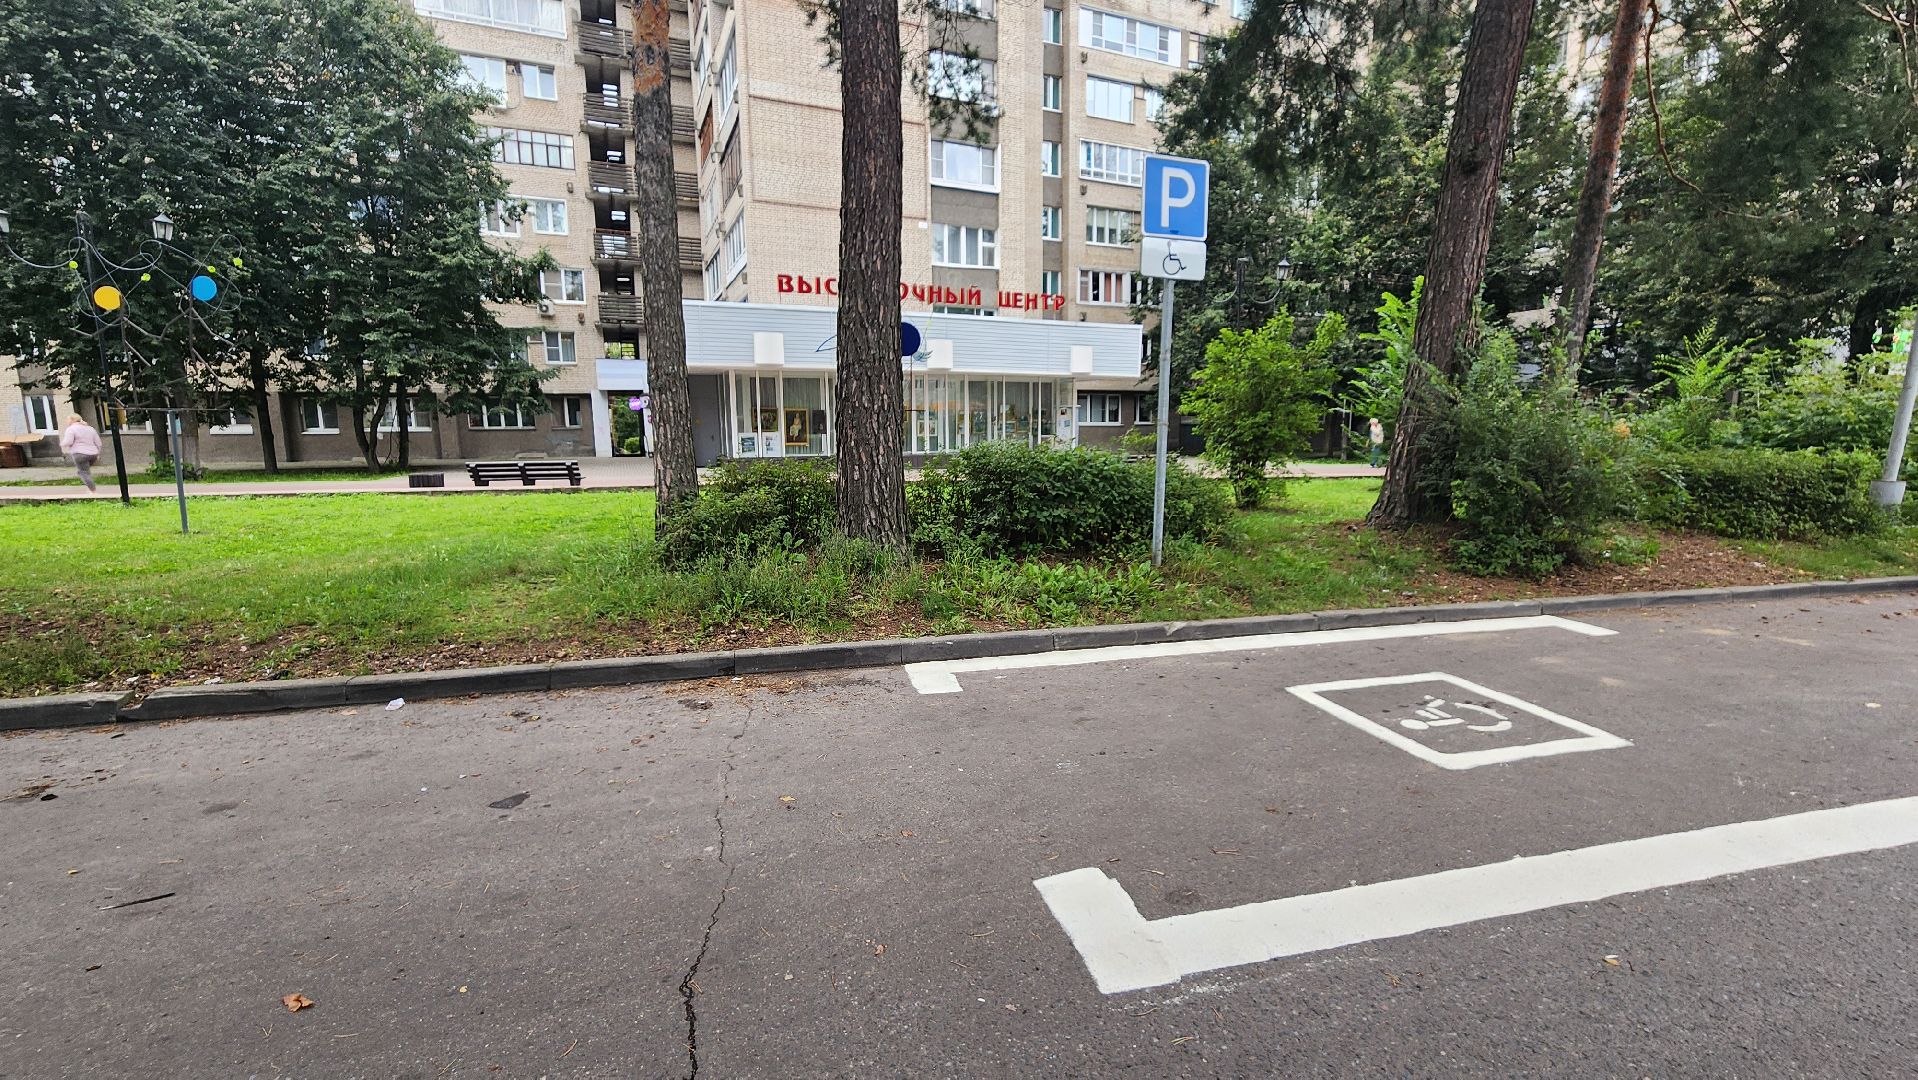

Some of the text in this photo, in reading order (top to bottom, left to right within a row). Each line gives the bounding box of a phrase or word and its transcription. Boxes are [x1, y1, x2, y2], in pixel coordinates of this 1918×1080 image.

[1161, 166, 1196, 228] P
[777, 274, 1065, 311] ВЫСОЧНЫЙ ЦЕНТР
